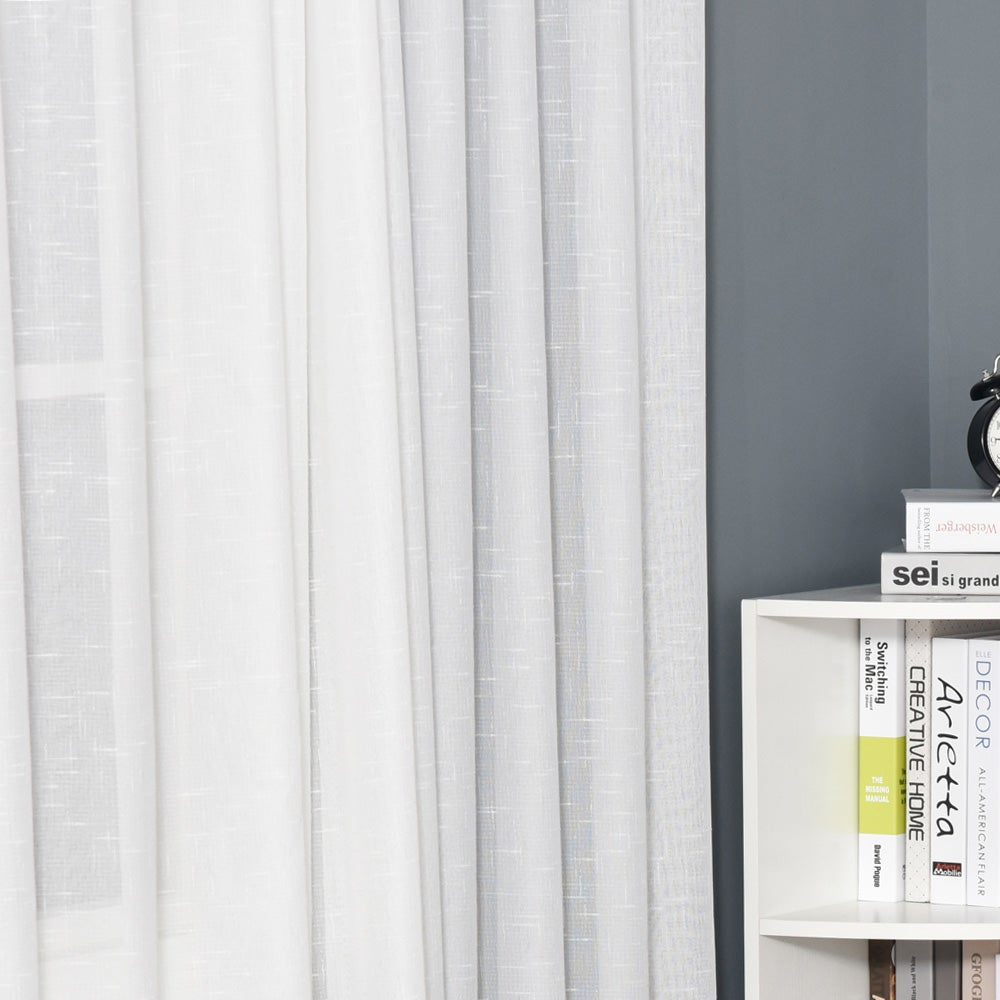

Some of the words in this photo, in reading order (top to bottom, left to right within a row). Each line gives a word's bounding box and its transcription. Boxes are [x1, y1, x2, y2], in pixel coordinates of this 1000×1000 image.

[923, 507, 931, 531] FROM
[936, 520, 997, 535] Weisberger
[923, 532, 931, 550] THE
[892, 560, 939, 586] sei
[942, 574, 954, 586] si
[864, 636, 871, 646] to
[864, 648, 872, 661] the
[864, 664, 876, 691] Mac
[875, 641, 888, 705] Switching
[975, 660, 992, 750] DECOR
[909, 665, 926, 773] CREATIVE
[936, 676, 964, 838] Arletta
[908, 782, 926, 842] HOME
[873, 844, 882, 862] David
[873, 865, 882, 888] Pogue
[977, 862, 986, 897] FLAIR
